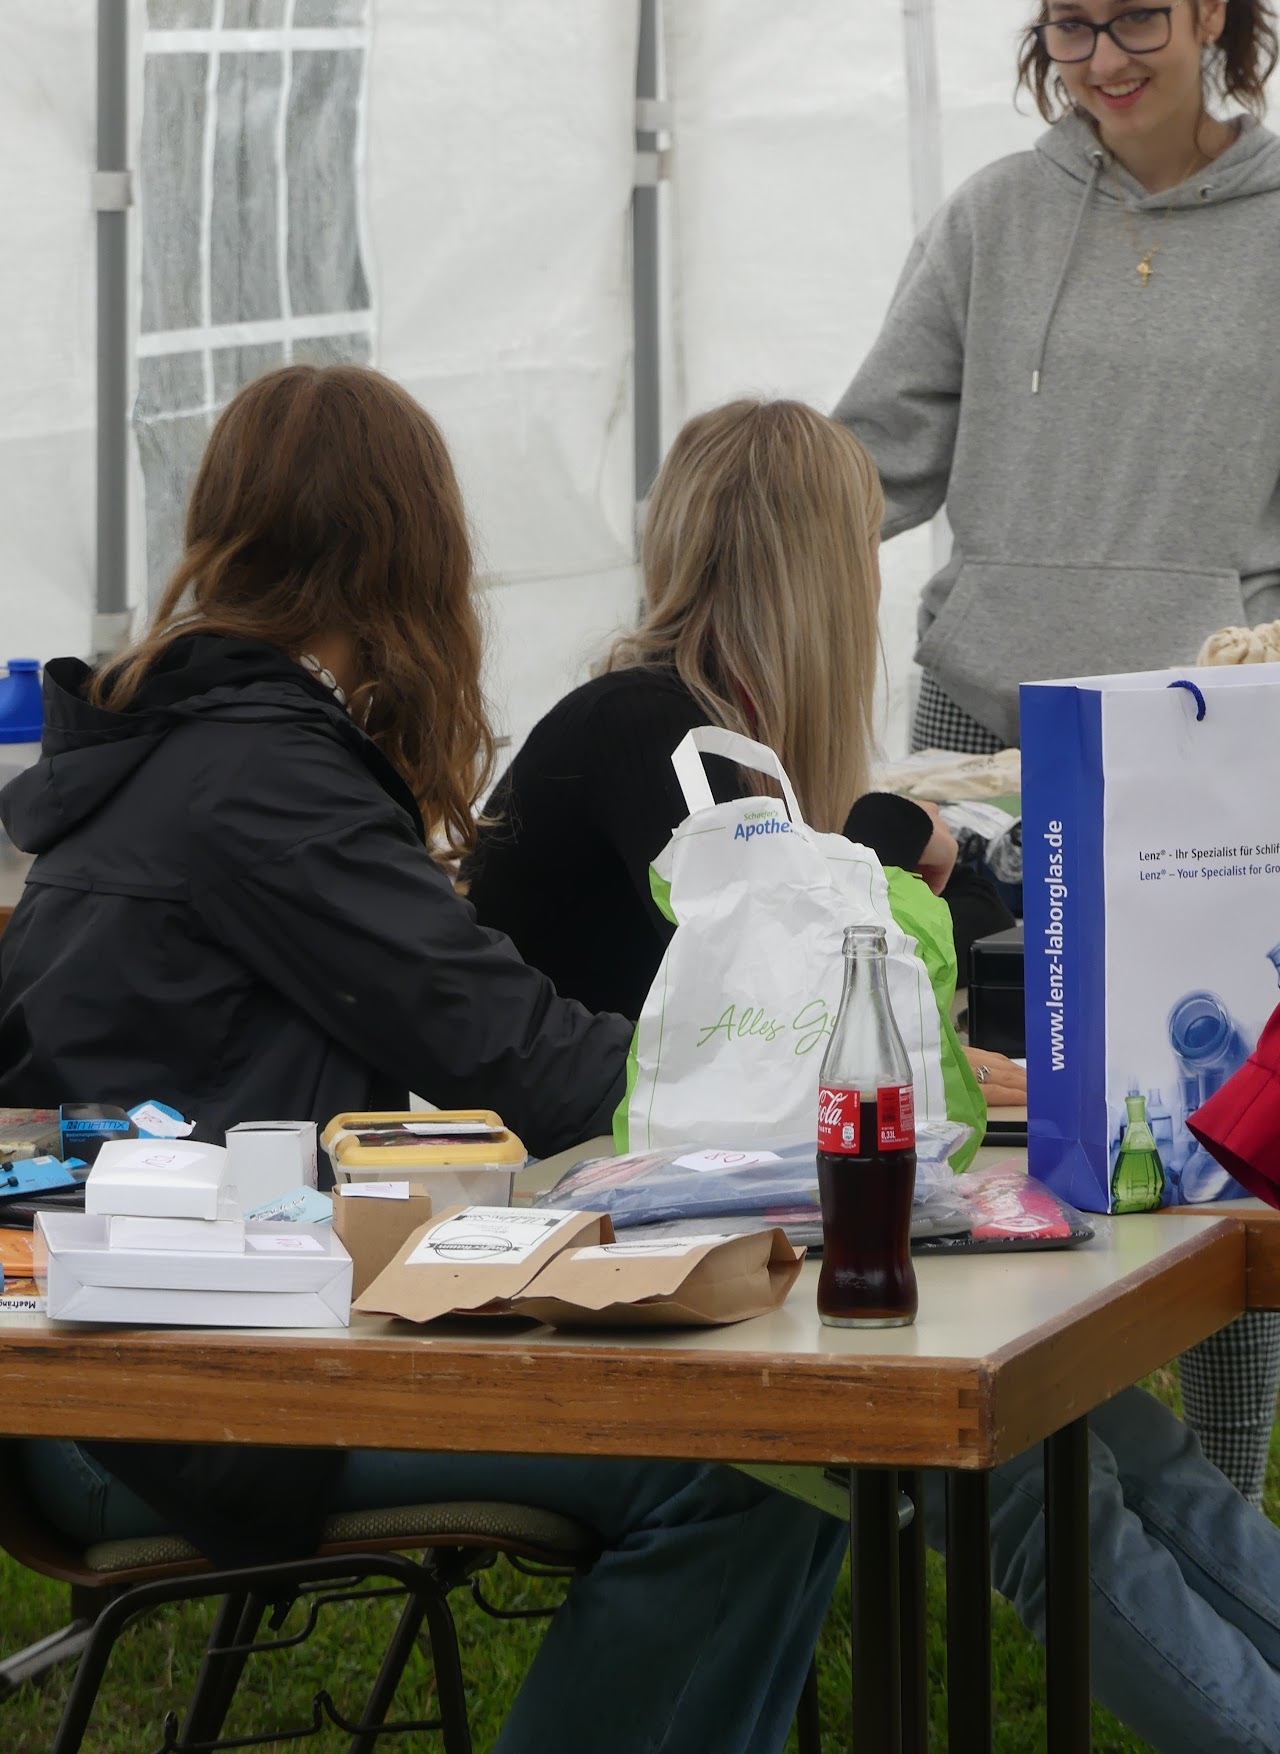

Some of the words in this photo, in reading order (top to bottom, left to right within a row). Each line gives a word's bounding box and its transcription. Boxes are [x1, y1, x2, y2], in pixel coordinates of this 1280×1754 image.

[734, 818, 793, 842] Apothe
[1175, 849, 1189, 859] Ihr
[1191, 847, 1237, 861] Spezialist
[1240, 845, 1253, 857] für
[1177, 868, 1198, 879] Your
[1201, 865, 1247, 880] Specialist
[1249, 864, 1263, 875] for
[1044, 820, 1067, 1072] www.lenz-laborglas.de
[696, 1004, 785, 1047] Alles
[880, 1130, 896, 1140] 0,33L
